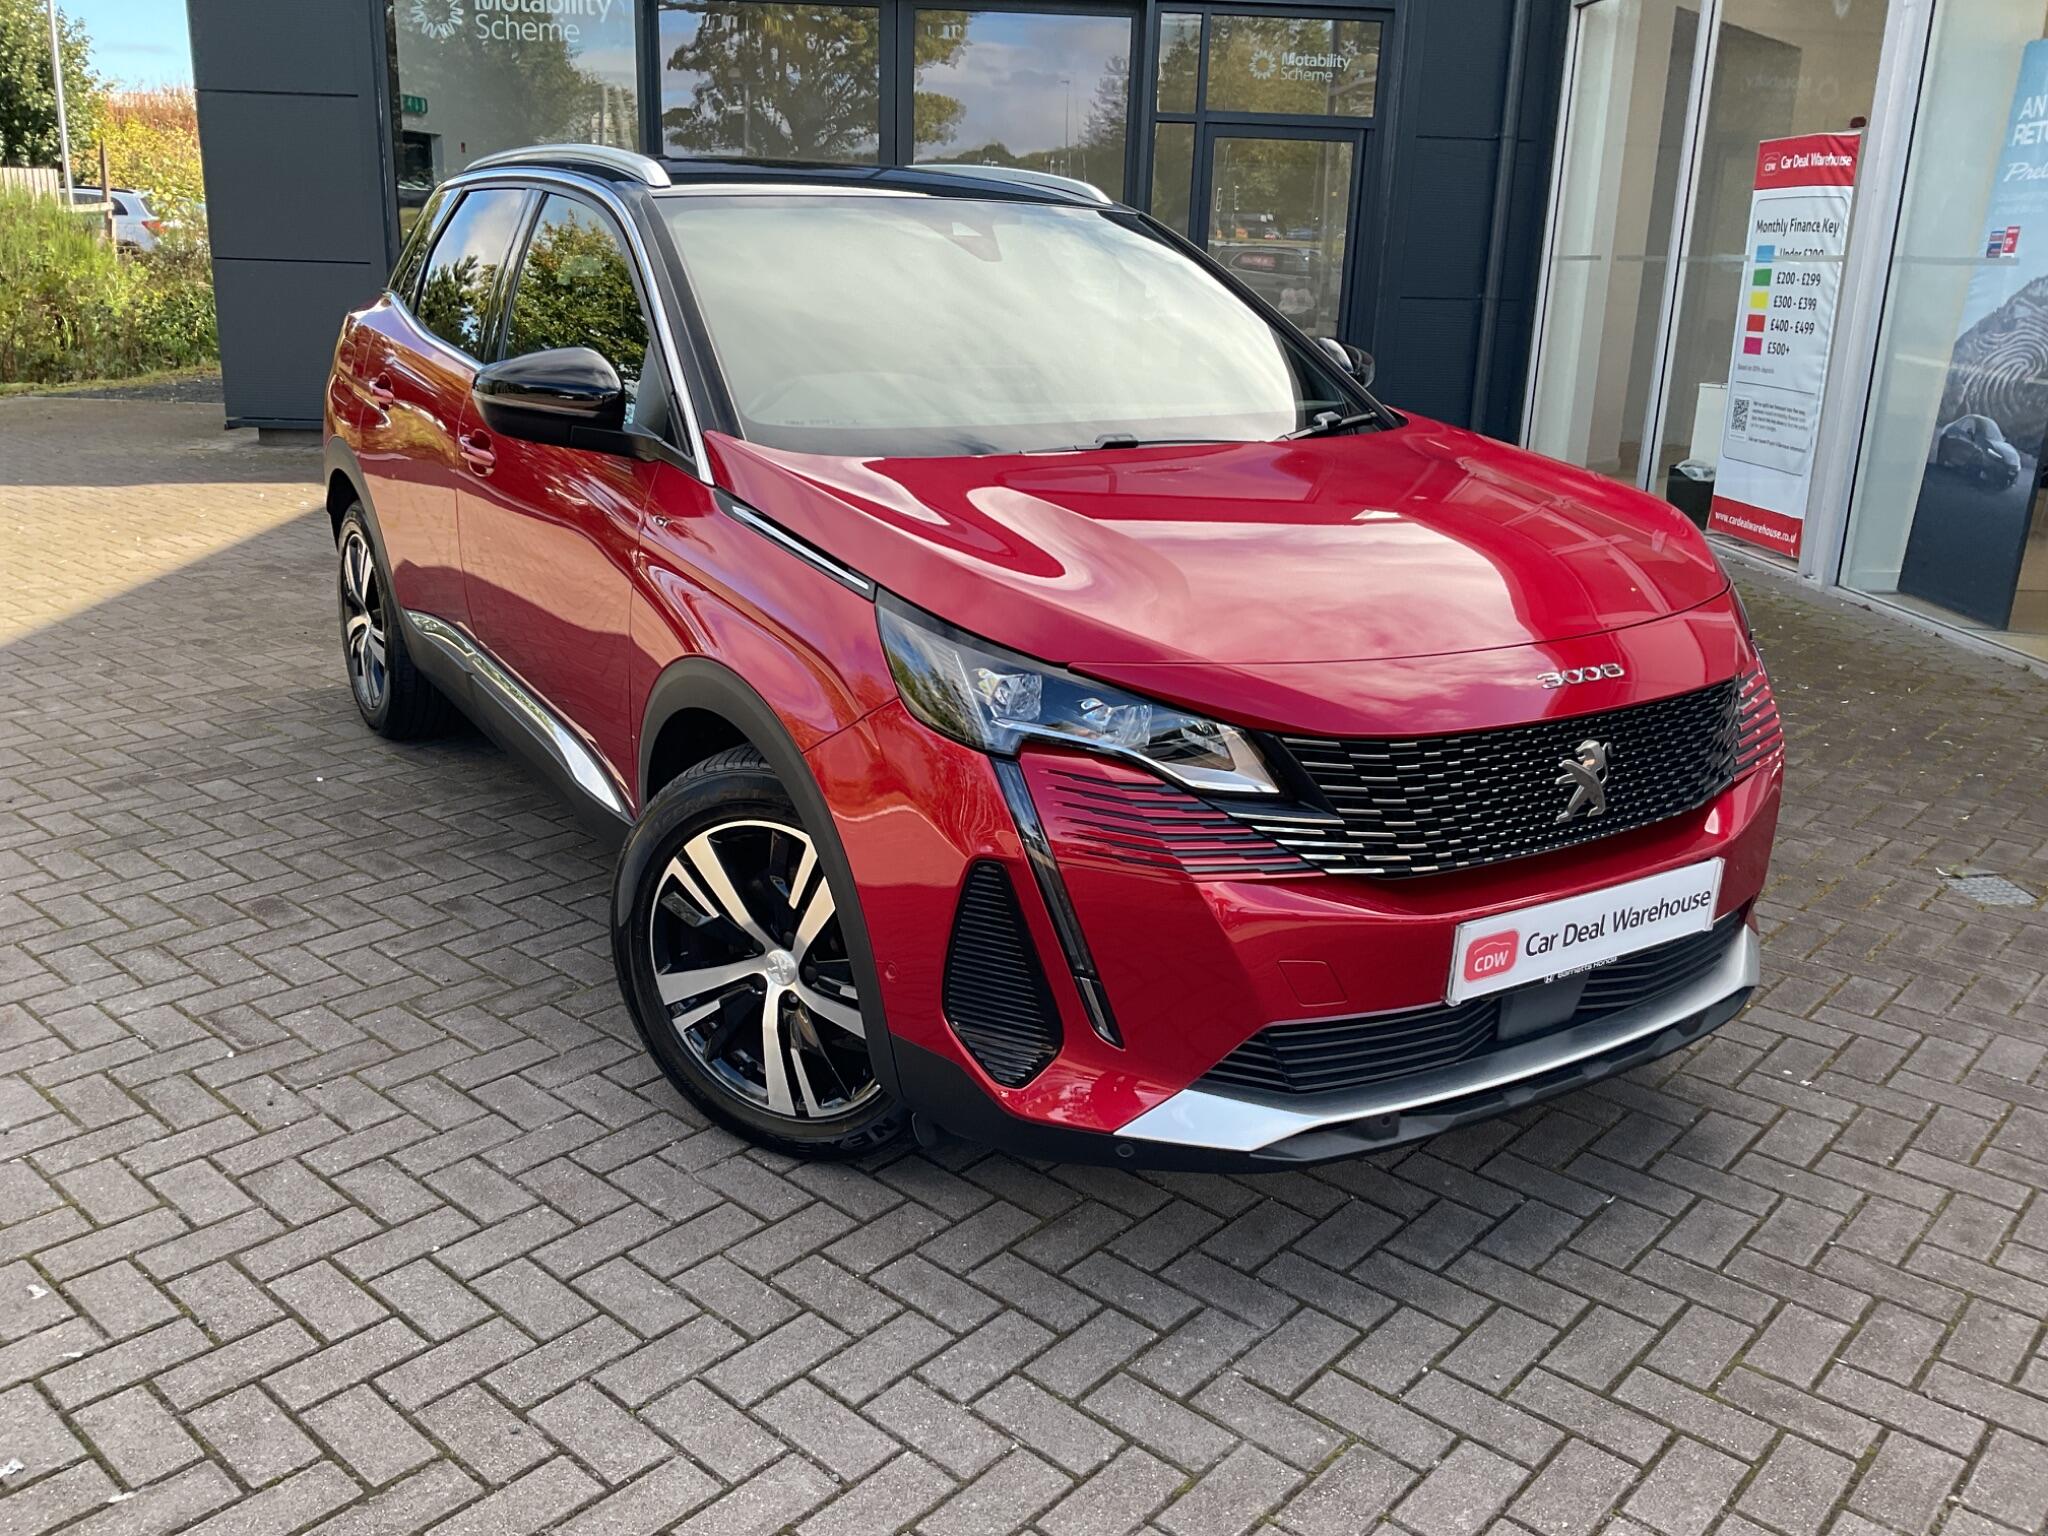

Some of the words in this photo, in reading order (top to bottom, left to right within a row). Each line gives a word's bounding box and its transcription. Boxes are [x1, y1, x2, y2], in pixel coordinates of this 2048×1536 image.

[475, 13, 580, 43] Scheme
[1281, 51, 1351, 72] Motability
[1280, 66, 1334, 82] Scheme
[1781, 155, 1793, 169] Car
[1793, 153, 1809, 168] Deal
[1810, 152, 1853, 167] Warehouse
[1756, 218, 1788, 237] Monthly
[1789, 218, 1820, 232] Finance
[1821, 218, 1840, 238] Key
[1776, 272, 1796, 285] £200
[1801, 273, 1822, 287] £299
[1773, 295, 1793, 309] £300
[1798, 297, 1817, 311] £399
[1770, 318, 1789, 332] £400
[1795, 321, 1815, 335] £499
[1767, 341, 1790, 356] £500+
[1536, 663, 1625, 689] 3008
[1526, 932, 1558, 957] Car
[1562, 914, 1605, 948] Deal
[1612, 889, 1711, 933] Warehouse
[1473, 950, 1508, 973] CDW
